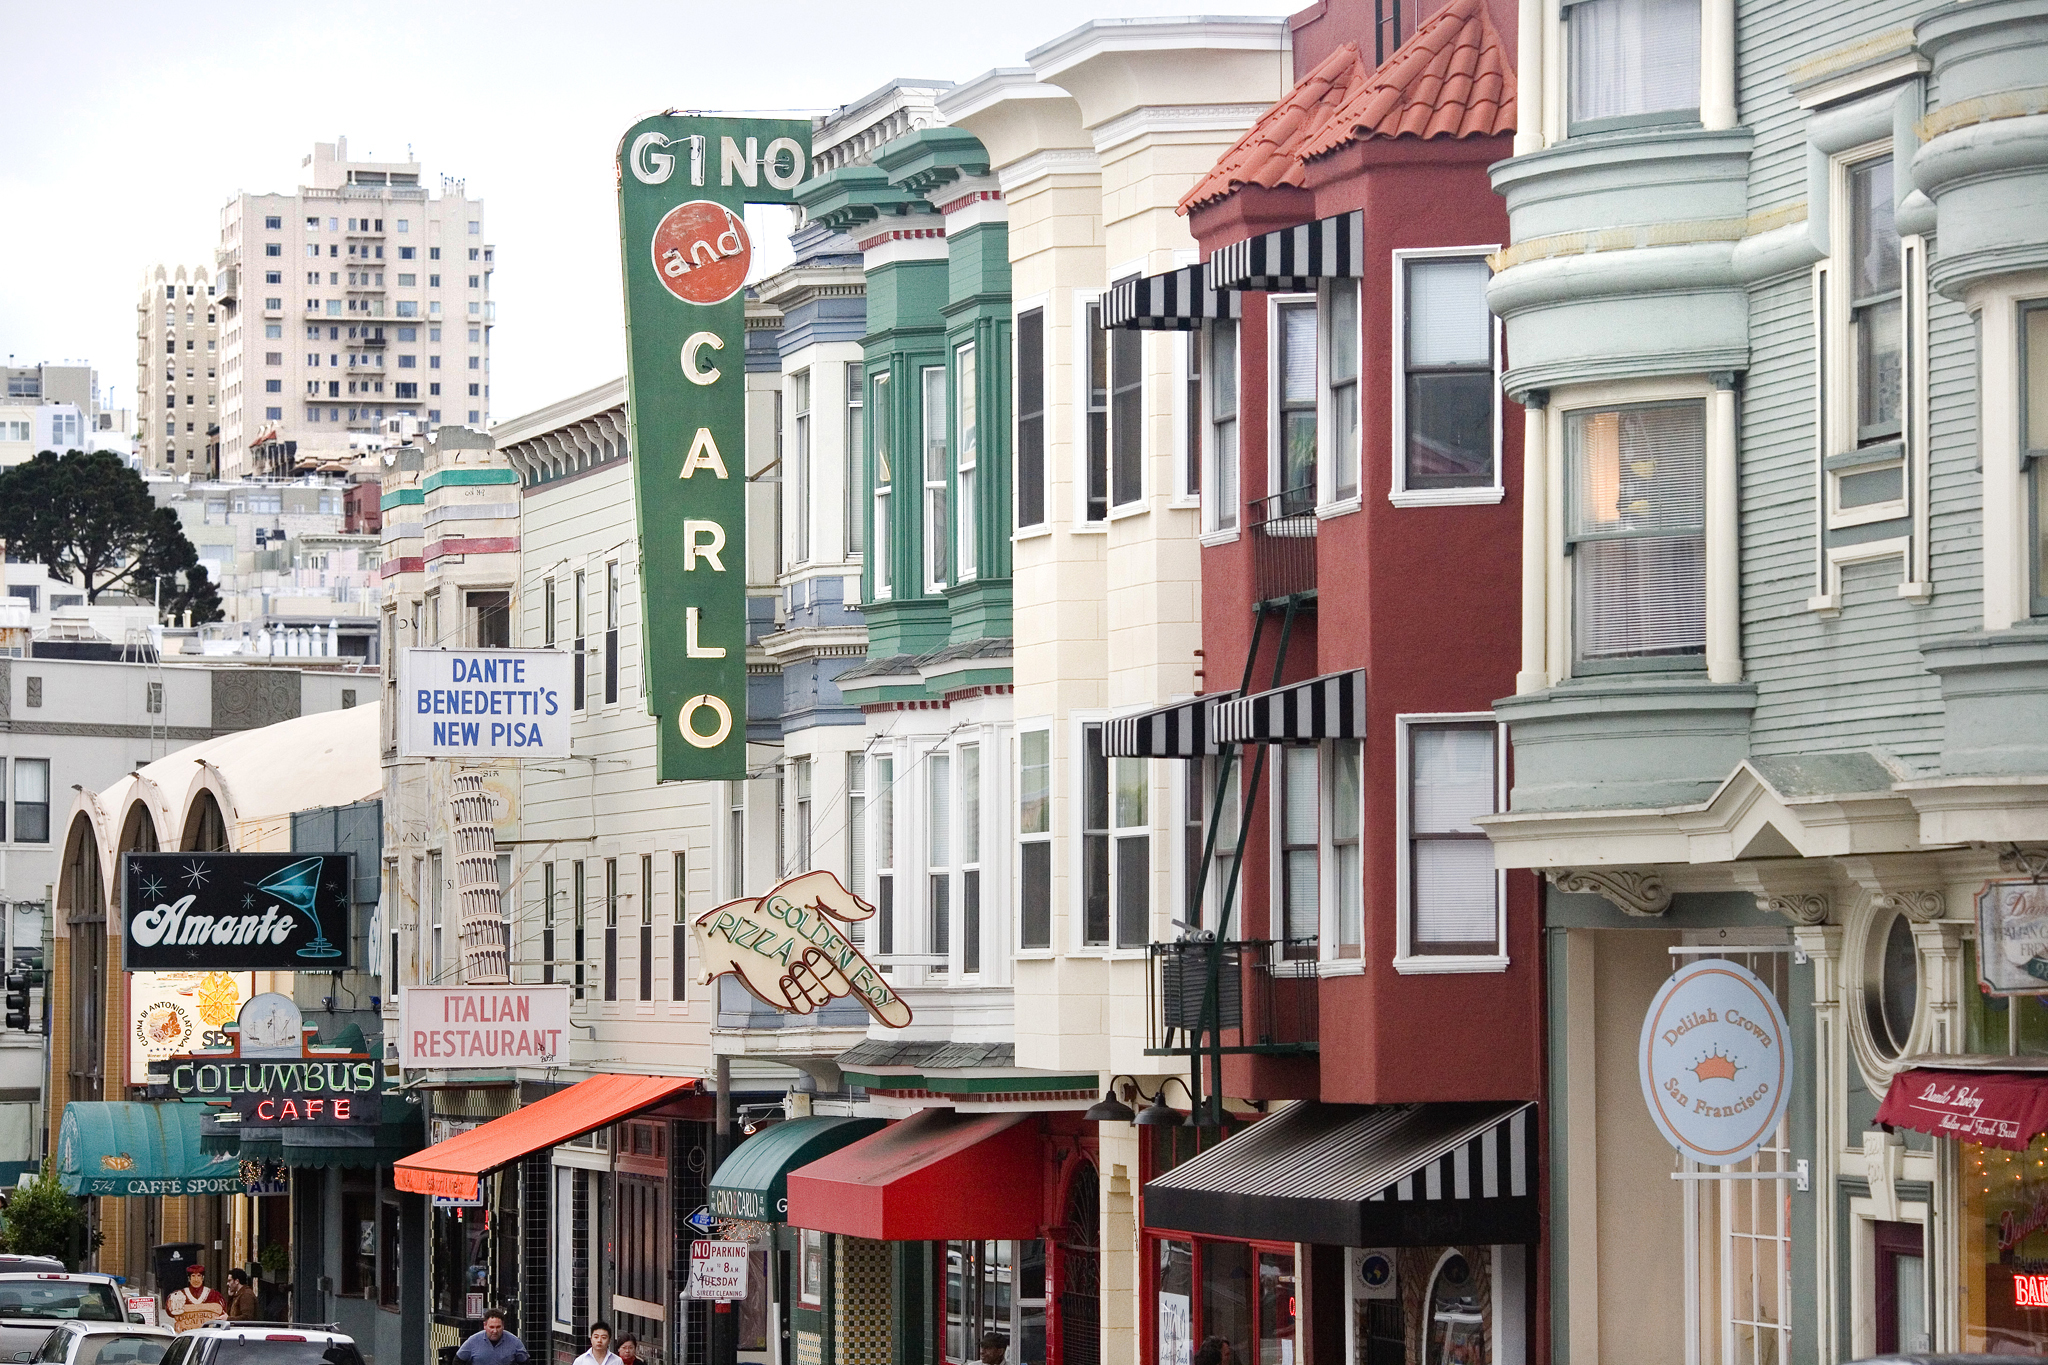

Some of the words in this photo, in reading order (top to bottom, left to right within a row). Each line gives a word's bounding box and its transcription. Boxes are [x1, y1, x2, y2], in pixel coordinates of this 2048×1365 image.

[630, 131, 806, 190] GINO
[662, 211, 744, 278] and
[678, 331, 733, 749] CARLO
[452, 658, 525, 684] DANTE
[417, 686, 559, 716] BENEDETTI'S
[433, 721, 480, 747] NEW
[491, 722, 544, 748] PISA
[131, 894, 298, 947] Amante
[707, 911, 796, 967] PIZZA
[766, 895, 857, 971] GOLDEN
[850, 966, 897, 1008] BOY
[140, 1010, 149, 1019] DI
[149, 1001, 186, 1016] ANTONIO
[444, 995, 530, 1023] ITALIAN
[136, 1019, 149, 1047] CUCINA
[1662, 1007, 1719, 1047] Delilah
[1725, 1009, 1773, 1048] Crown
[413, 1029, 562, 1058] RESTAURANT
[173, 1061, 375, 1095] COLUMBUS
[258, 1097, 351, 1122] CAFE
[1663, 1077, 1689, 1107] San
[1693, 1081, 1769, 1118] Francisco
[91, 1180, 116, 1192] 574
[128, 1177, 182, 1194] CAFFÉ
[187, 1177, 240, 1193] SPORT
[716, 1189, 733, 1216] GINO
[737, 1191, 759, 1218] CARLO
[694, 1242, 710, 1258] NO
[711, 1246, 746, 1258] PARKING
[699, 1261, 706, 1272] 7
[723, 1262, 730, 1273] 8
[700, 1276, 739, 1287] TUESDAY
